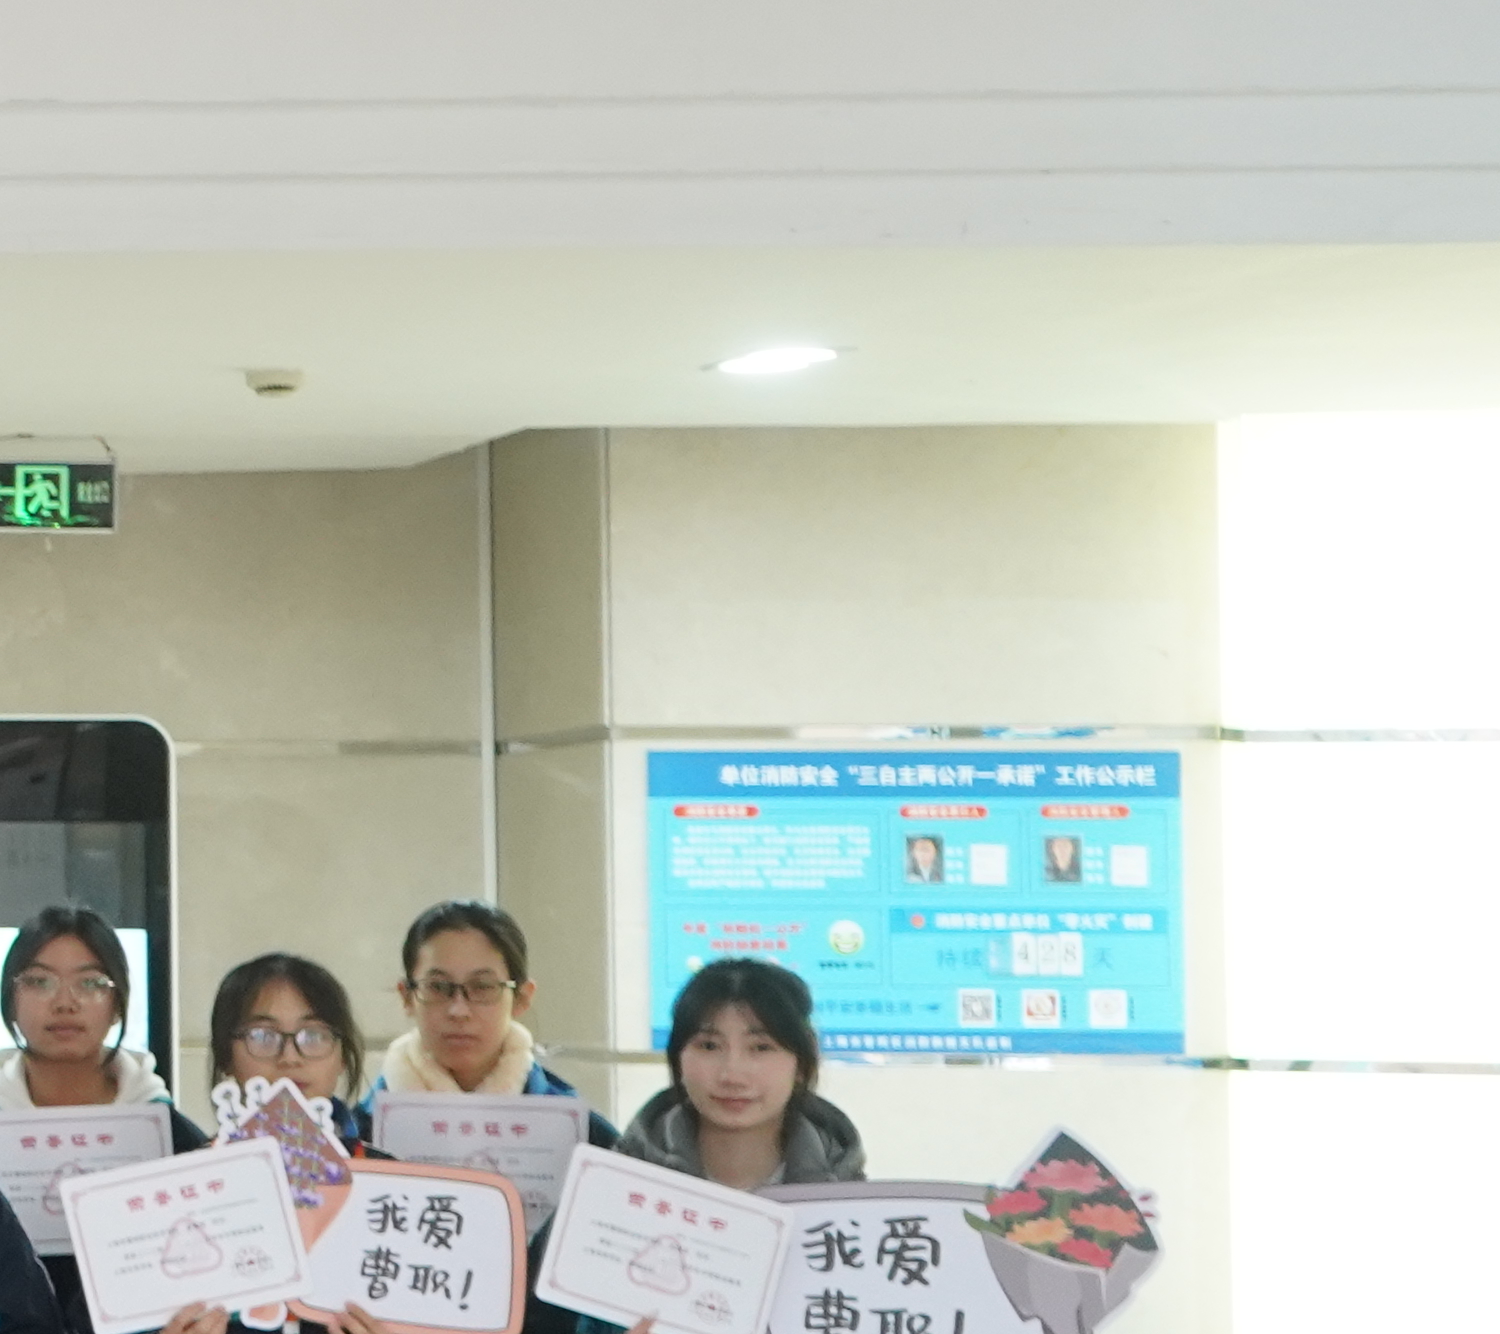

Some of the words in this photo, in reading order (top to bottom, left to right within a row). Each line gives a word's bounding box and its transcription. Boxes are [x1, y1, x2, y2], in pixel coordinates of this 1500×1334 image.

[366, 1193, 463, 1251] 我爱
[802, 1216, 940, 1287] 我爱
[360, 1247, 473, 1310] 曹职！
